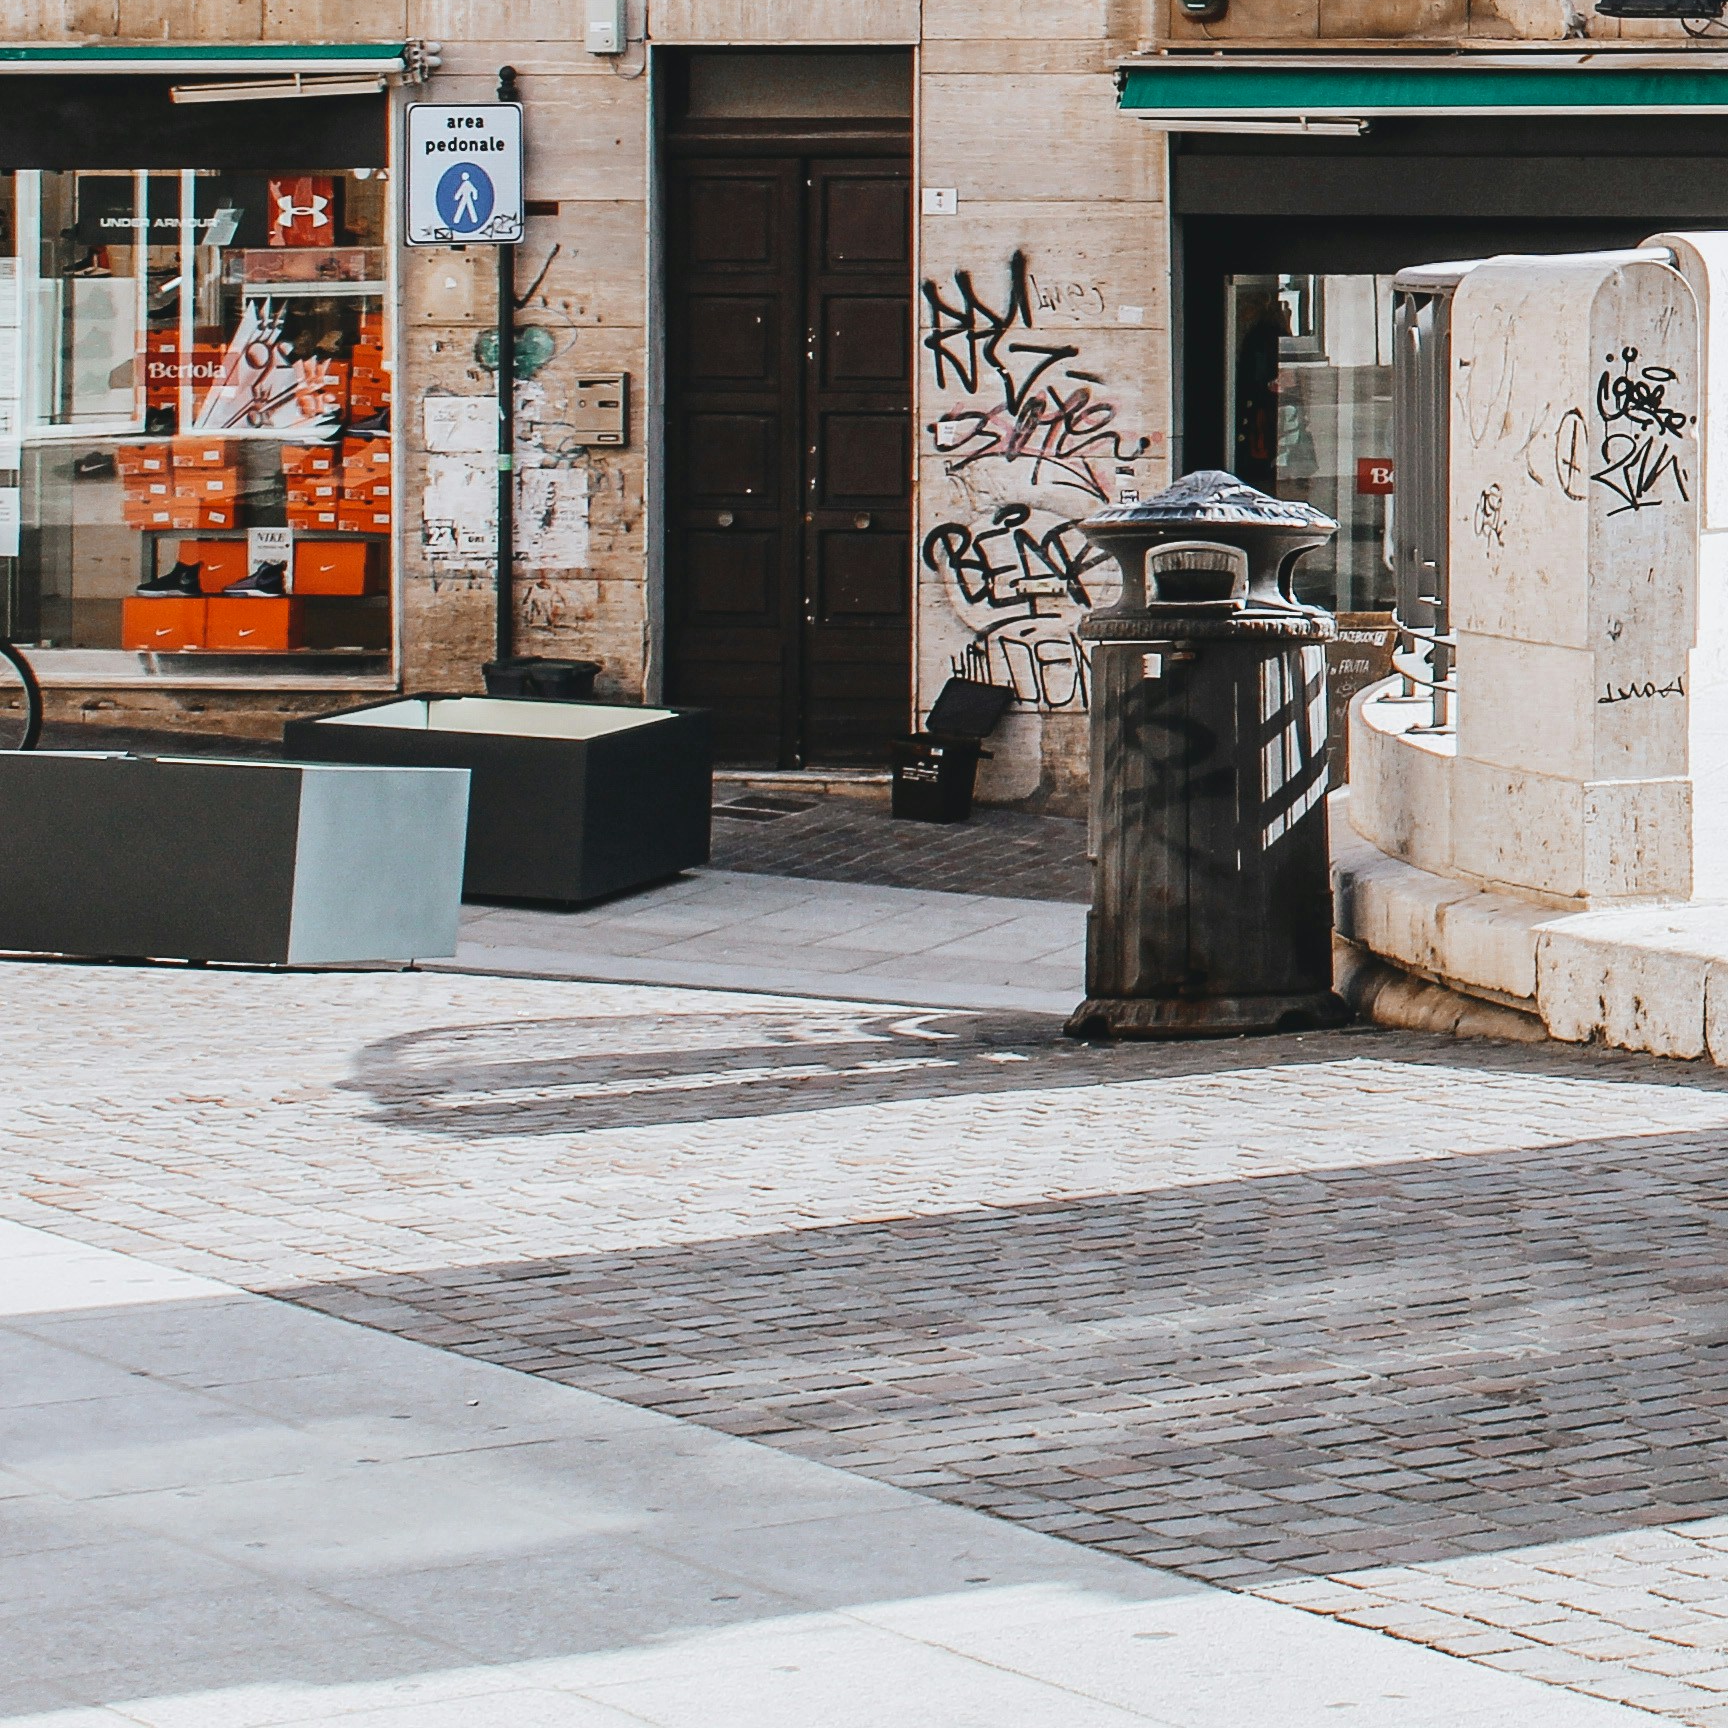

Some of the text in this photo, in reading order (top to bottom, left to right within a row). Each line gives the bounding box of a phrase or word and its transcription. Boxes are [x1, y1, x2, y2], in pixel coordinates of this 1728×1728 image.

[447, 117, 485, 129] area
[425, 136, 505, 155] pedonale
[100, 217, 219, 229] UNDER ARMOUR
[148, 360, 227, 381] Bertola
[256, 531, 286, 544] NIKE
[1339, 658, 1370, 675] FRUTTA
